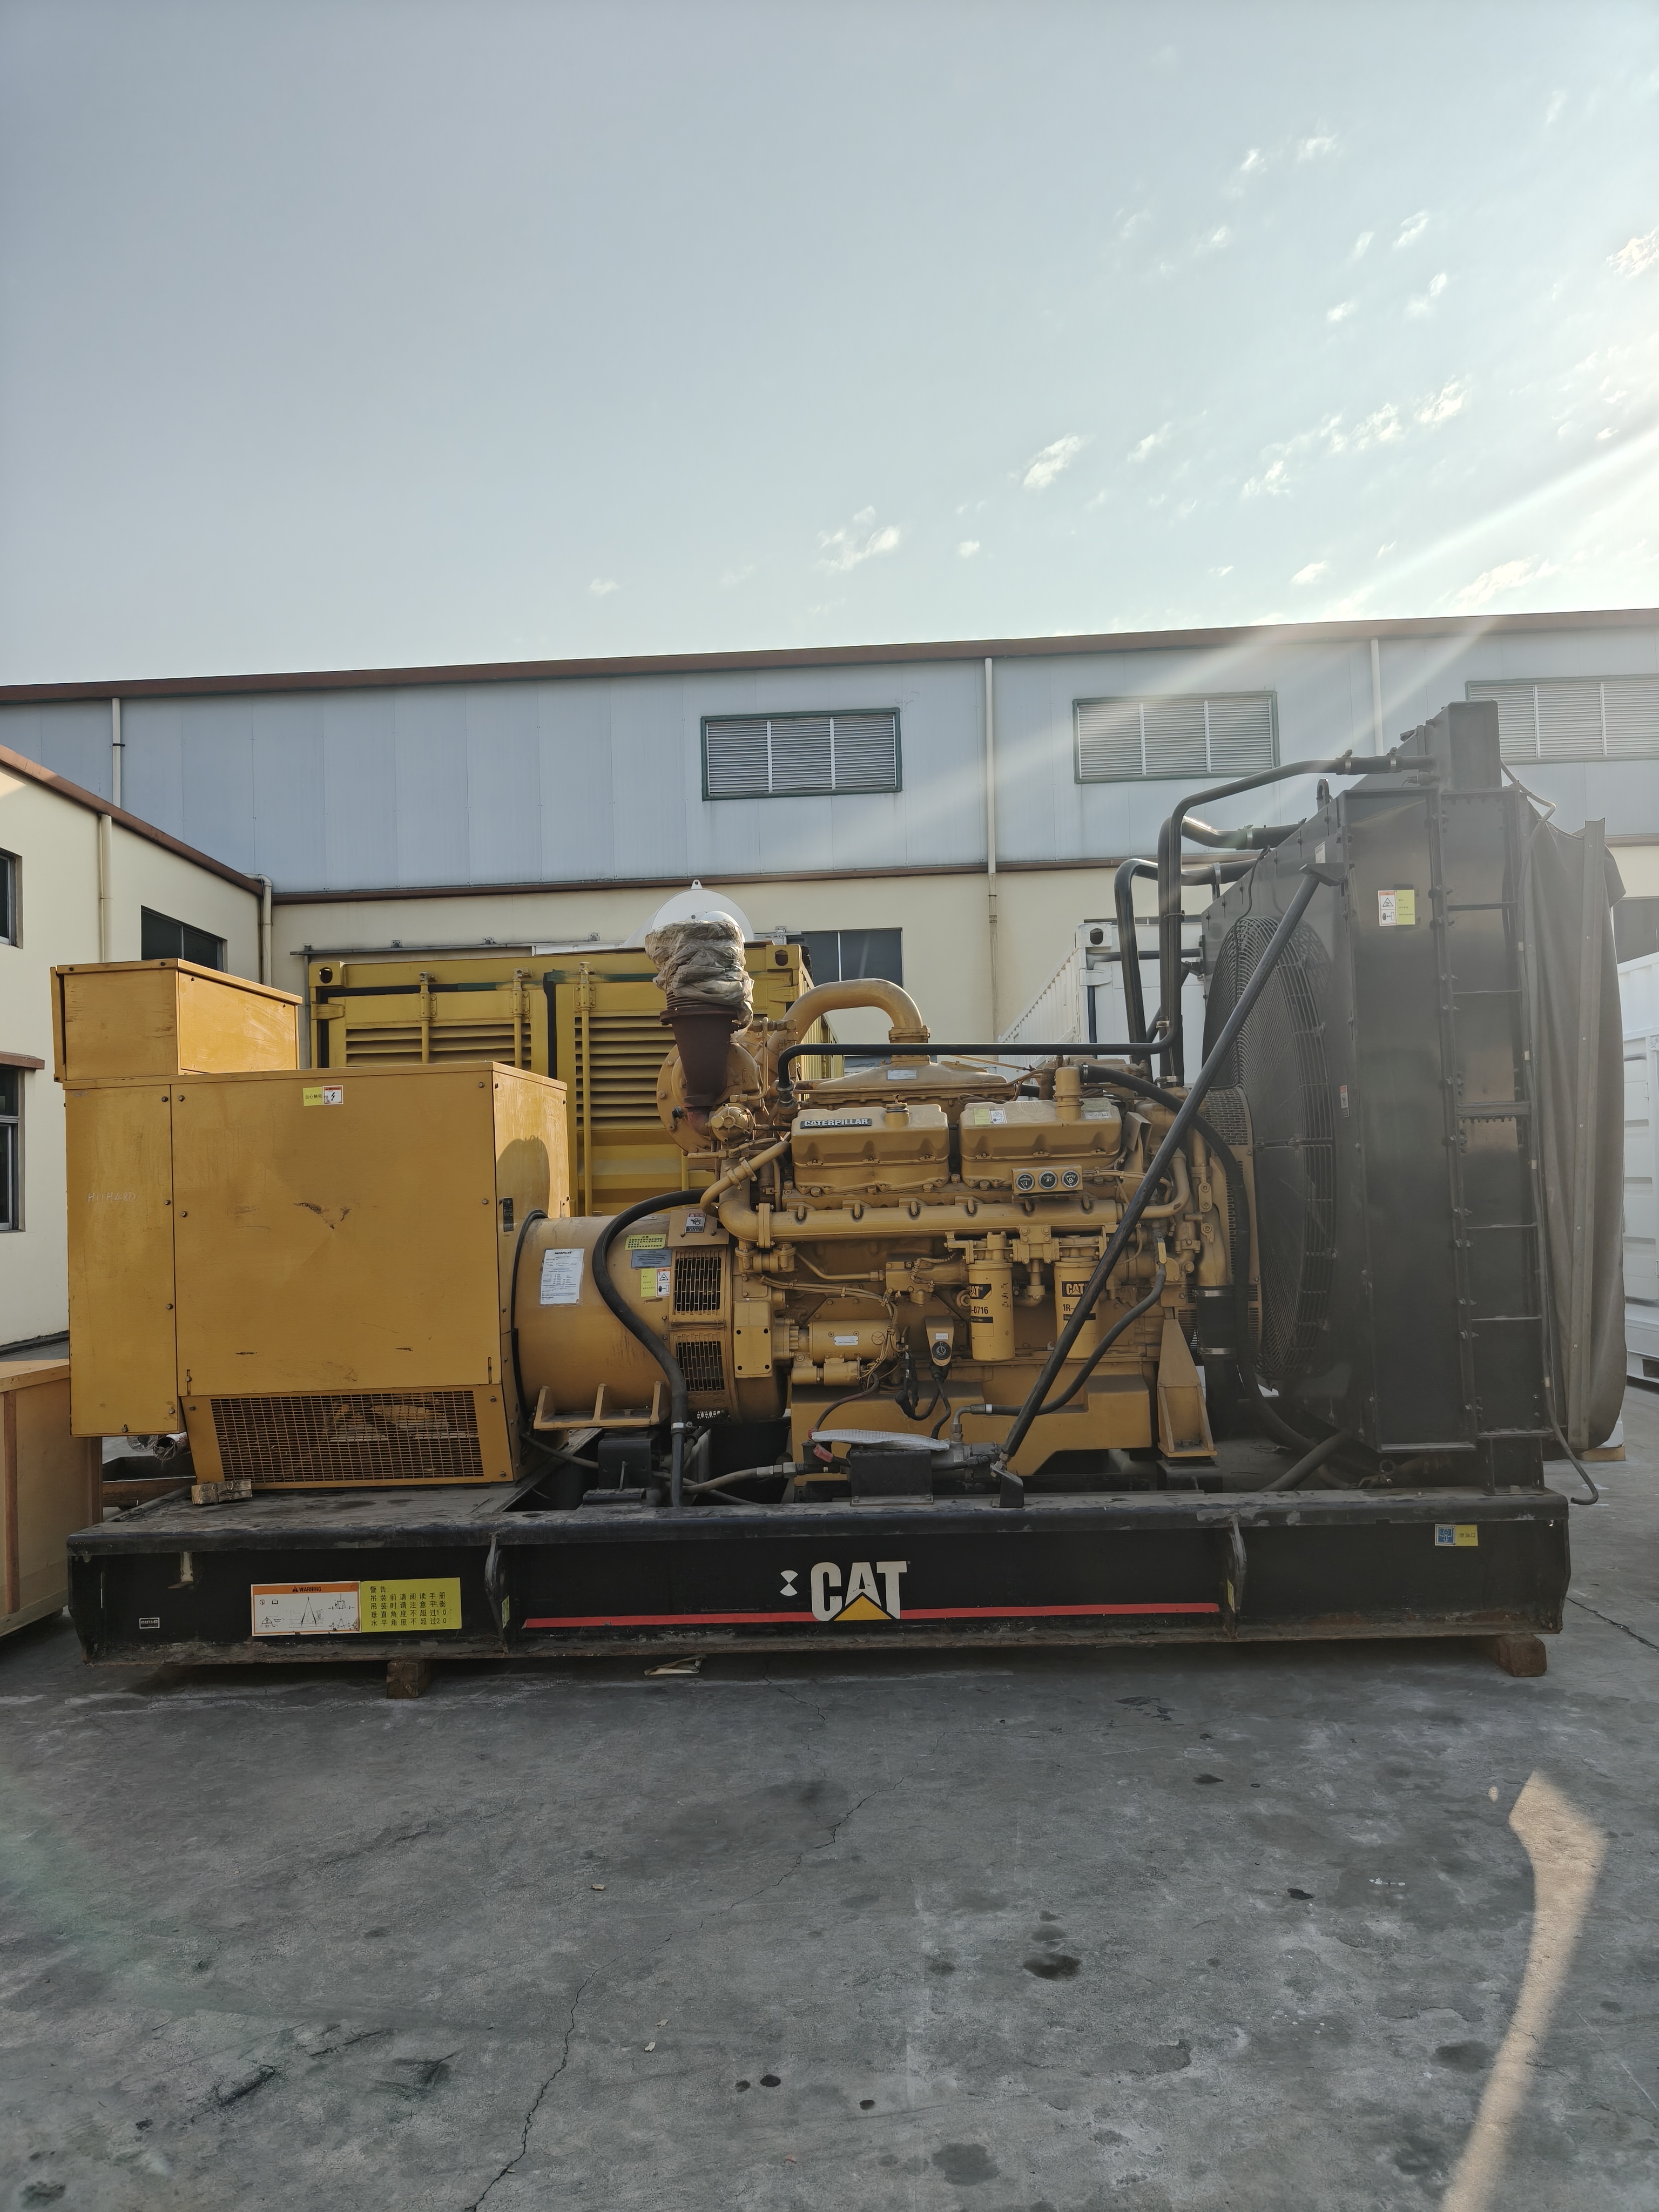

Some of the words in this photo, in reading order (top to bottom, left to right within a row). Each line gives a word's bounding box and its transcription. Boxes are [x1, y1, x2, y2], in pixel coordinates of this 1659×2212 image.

[804, 1118, 868, 1127] CATERPILLAR
[970, 1286, 980, 1297] AT
[1066, 1283, 1084, 1295] CAT
[811, 1561, 907, 1621] CAT
